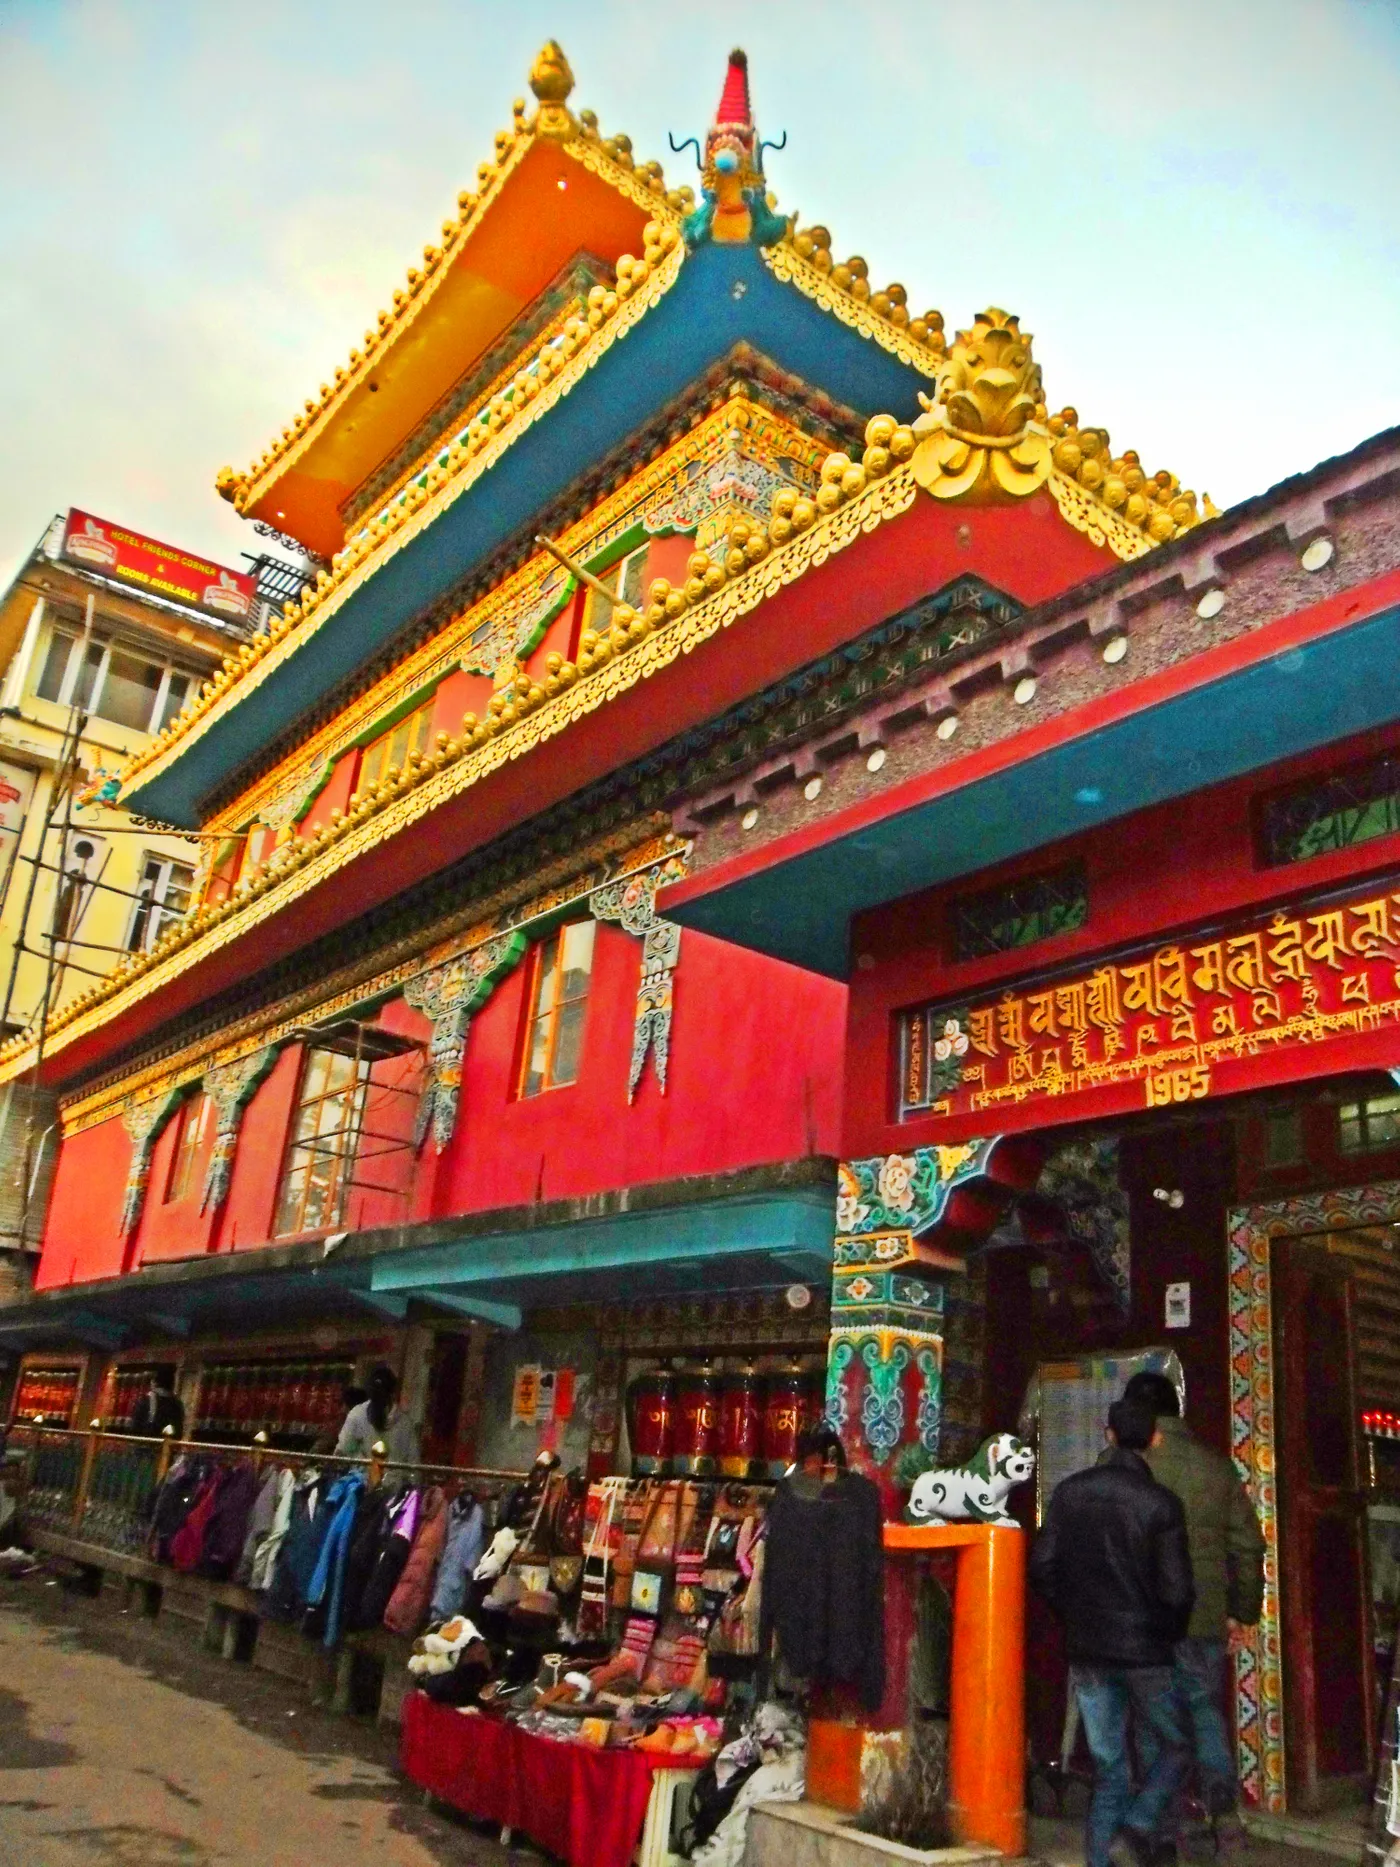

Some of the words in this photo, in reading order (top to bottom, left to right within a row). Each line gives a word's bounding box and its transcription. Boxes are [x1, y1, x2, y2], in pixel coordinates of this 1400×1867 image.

[111, 530, 139, 547] HOTEL
[142, 542, 179, 561] FRIENDS
[181, 557, 216, 576] CORNER
[156, 564, 164, 573] &
[116, 564, 150, 584] ROOMS
[150, 577, 199, 601] AVAILABLE
[1145, 1064, 1211, 1108] 1965
